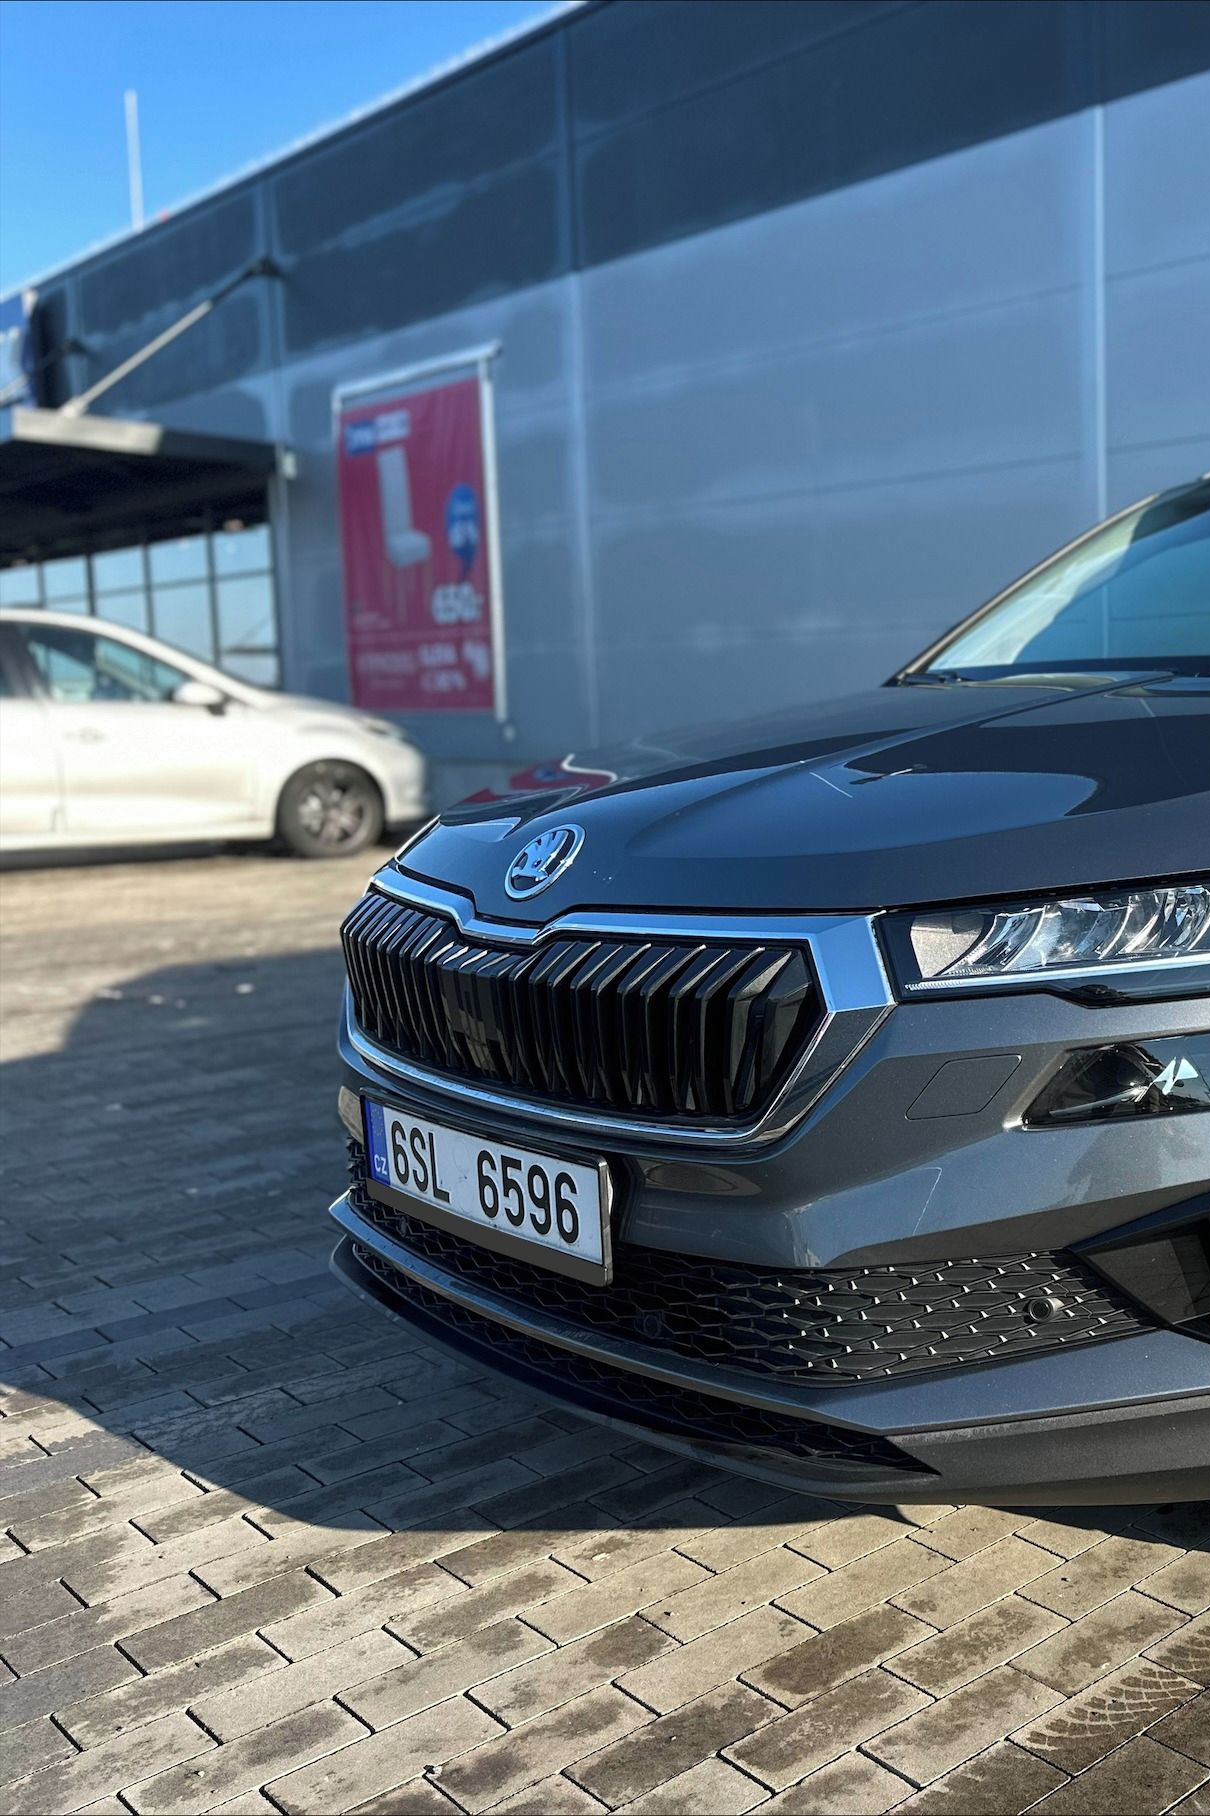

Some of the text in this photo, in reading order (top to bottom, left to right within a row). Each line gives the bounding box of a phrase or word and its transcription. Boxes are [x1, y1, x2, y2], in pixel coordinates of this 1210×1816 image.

[374, 1154, 388, 1176] CZ
[391, 1120, 579, 1244] 6SL 6596
